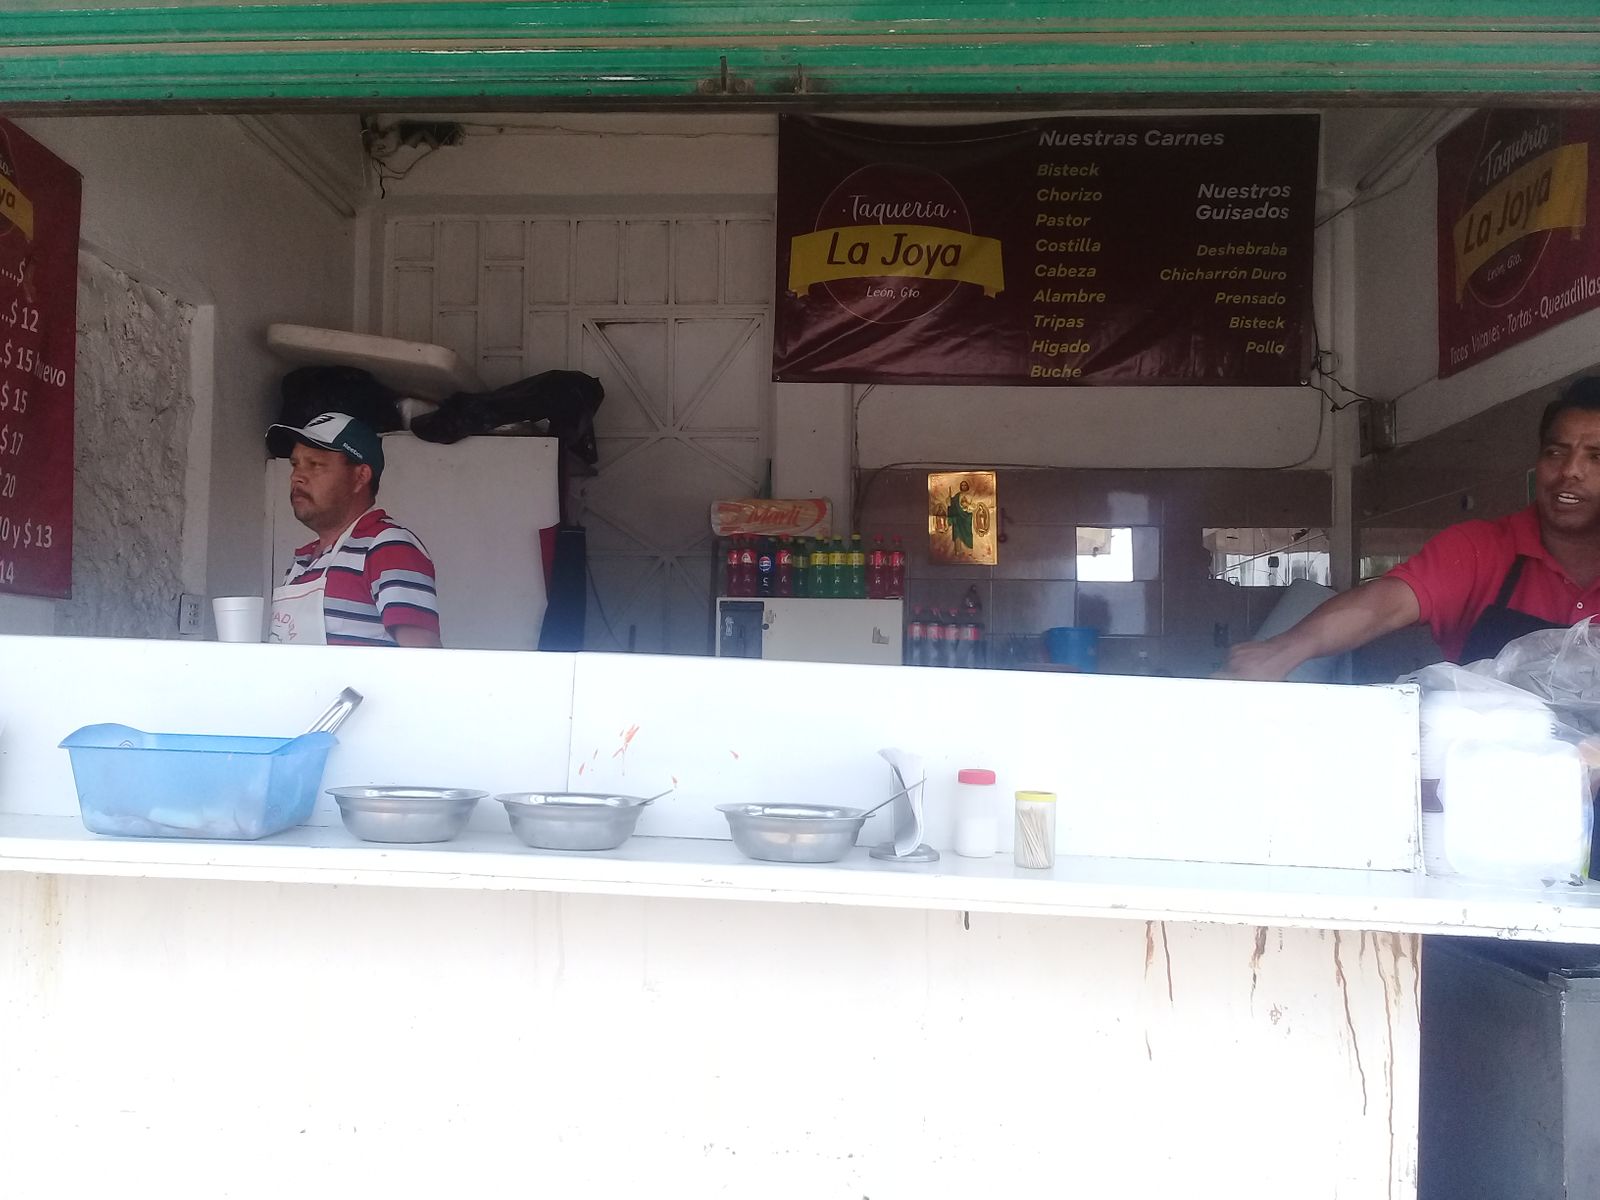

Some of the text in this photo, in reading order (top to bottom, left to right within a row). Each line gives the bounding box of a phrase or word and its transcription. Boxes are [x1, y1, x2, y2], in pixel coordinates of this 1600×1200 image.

[1038, 130, 1225, 147] Nuestras Carnes
[1036, 163, 1100, 177] Bisteck
[1036, 187, 1103, 202] Chorizo
[1197, 183, 1292, 199] Nuestros
[1195, 202, 1290, 220] Guisados
[1463, 167, 1553, 255] La Joya
[1035, 213, 1091, 227] Pastor
[826, 231, 962, 275] La Joya
[1035, 238, 1101, 252] Costilla
[1196, 242, 1288, 256] Deshebraba
[1034, 263, 1097, 277] Cabeza
[1159, 267, 1287, 281] Chicharrón Duro
[1033, 288, 1106, 303] Alambre
[1215, 292, 1286, 305] Prensado
[21, 306, 39, 333] 12
[1034, 314, 1085, 331] Tripas
[1228, 316, 1285, 329] Bisteck
[1507, 308, 1532, 335] Tortas
[1031, 339, 1090, 357] Higado
[1246, 341, 1285, 355] Pollo
[17, 347, 33, 372] 15
[34, 352, 66, 387] huevo
[1030, 364, 1082, 378] Buche
[0, 380, 28, 413] $ 15
[9, 431, 23, 455] 17
[2, 473, 16, 498] 20
[13, 524, 21, 549] y
[23, 517, 32, 549] $
[35, 524, 52, 548] 13
